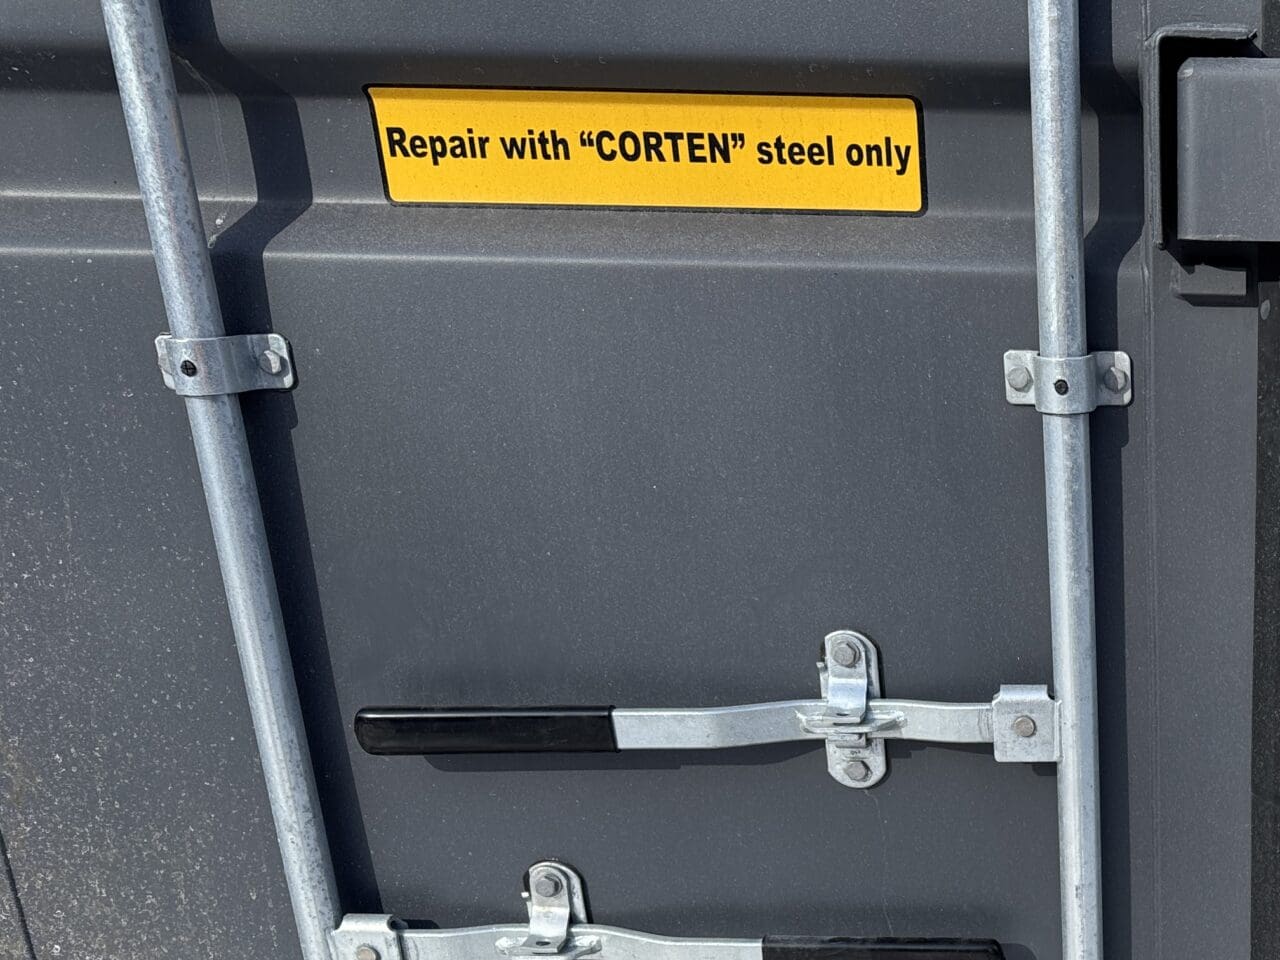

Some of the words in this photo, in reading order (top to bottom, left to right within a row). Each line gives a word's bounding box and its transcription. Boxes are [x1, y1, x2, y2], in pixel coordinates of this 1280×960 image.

[386, 126, 490, 166] Repair
[501, 129, 571, 161] with
[757, 135, 835, 166] steel
[846, 137, 912, 175] only
